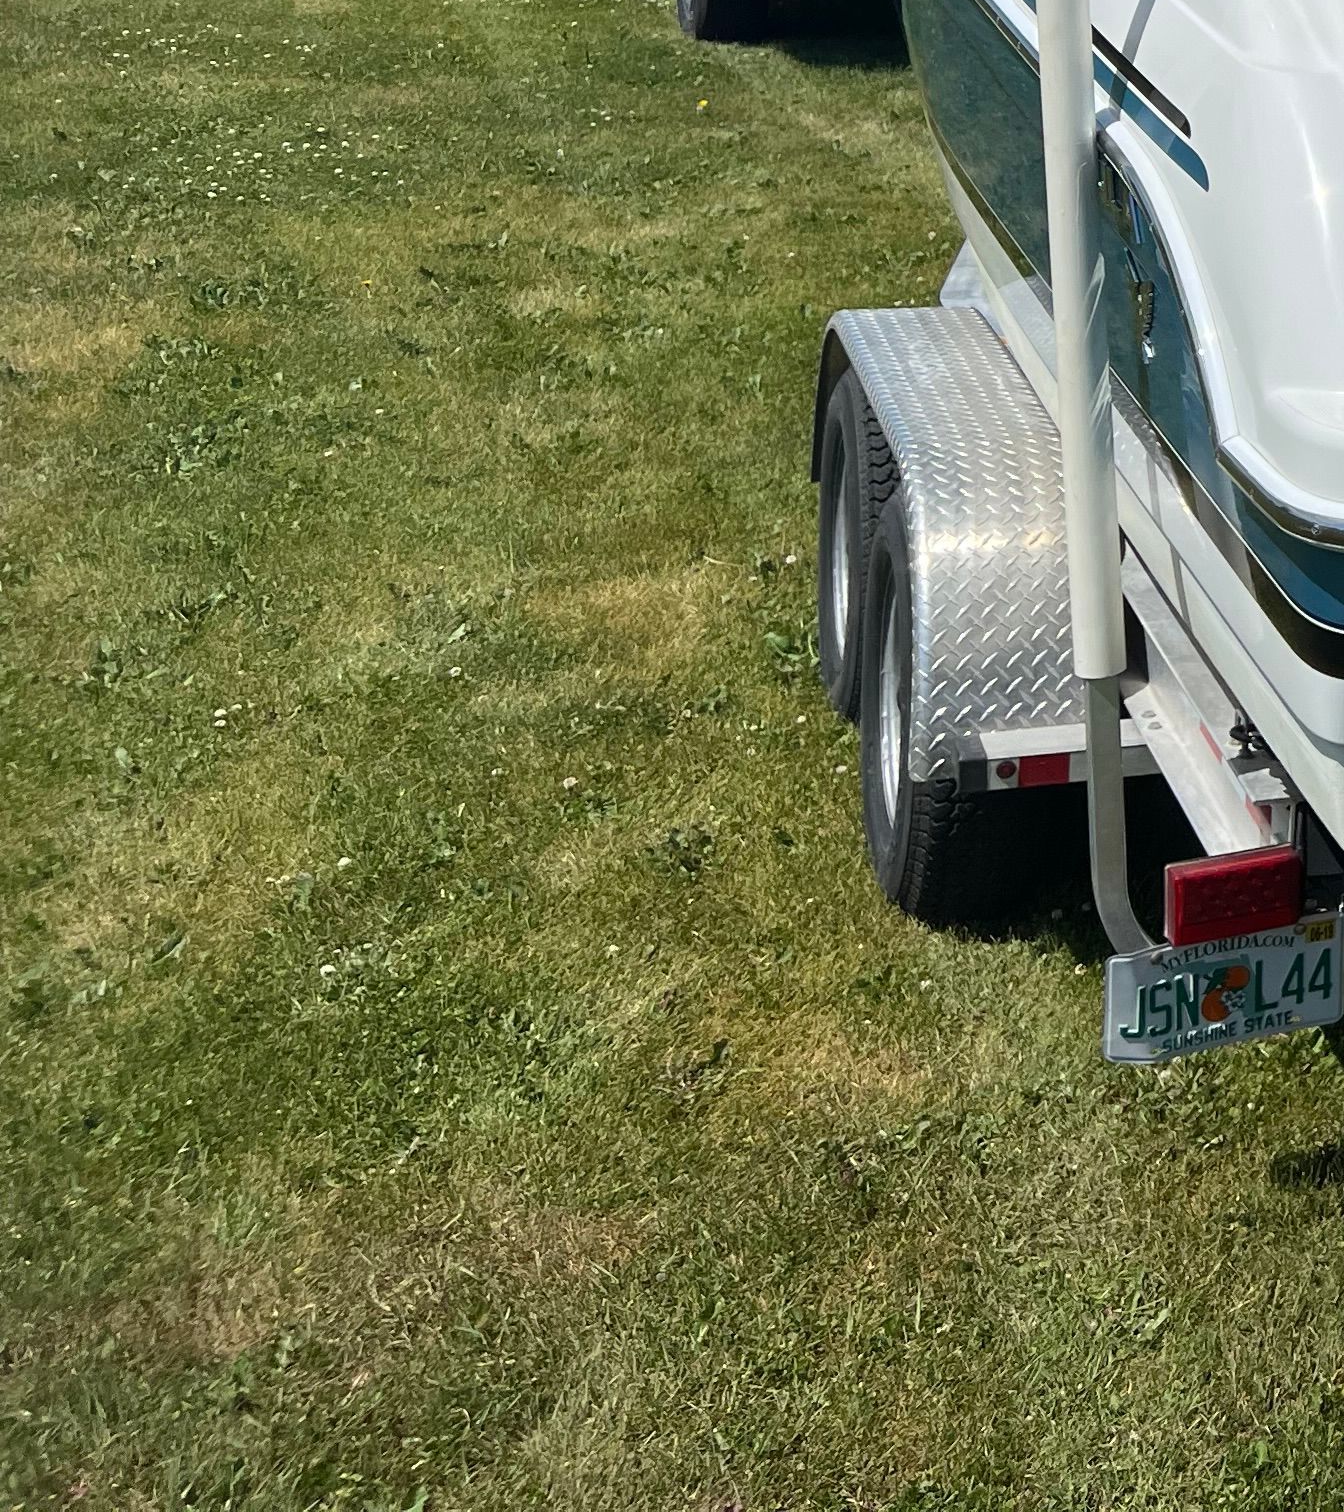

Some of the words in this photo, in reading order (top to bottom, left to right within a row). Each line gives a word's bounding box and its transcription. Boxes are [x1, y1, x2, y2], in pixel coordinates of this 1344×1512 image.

[1161, 934, 1296, 973] MYFLORIDA.COM
[1119, 973, 1200, 1039] JSN
[1255, 948, 1332, 1013] L44
[1162, 1021, 1238, 1052] SUNSHINE
[1243, 1010, 1293, 1034] STATE
